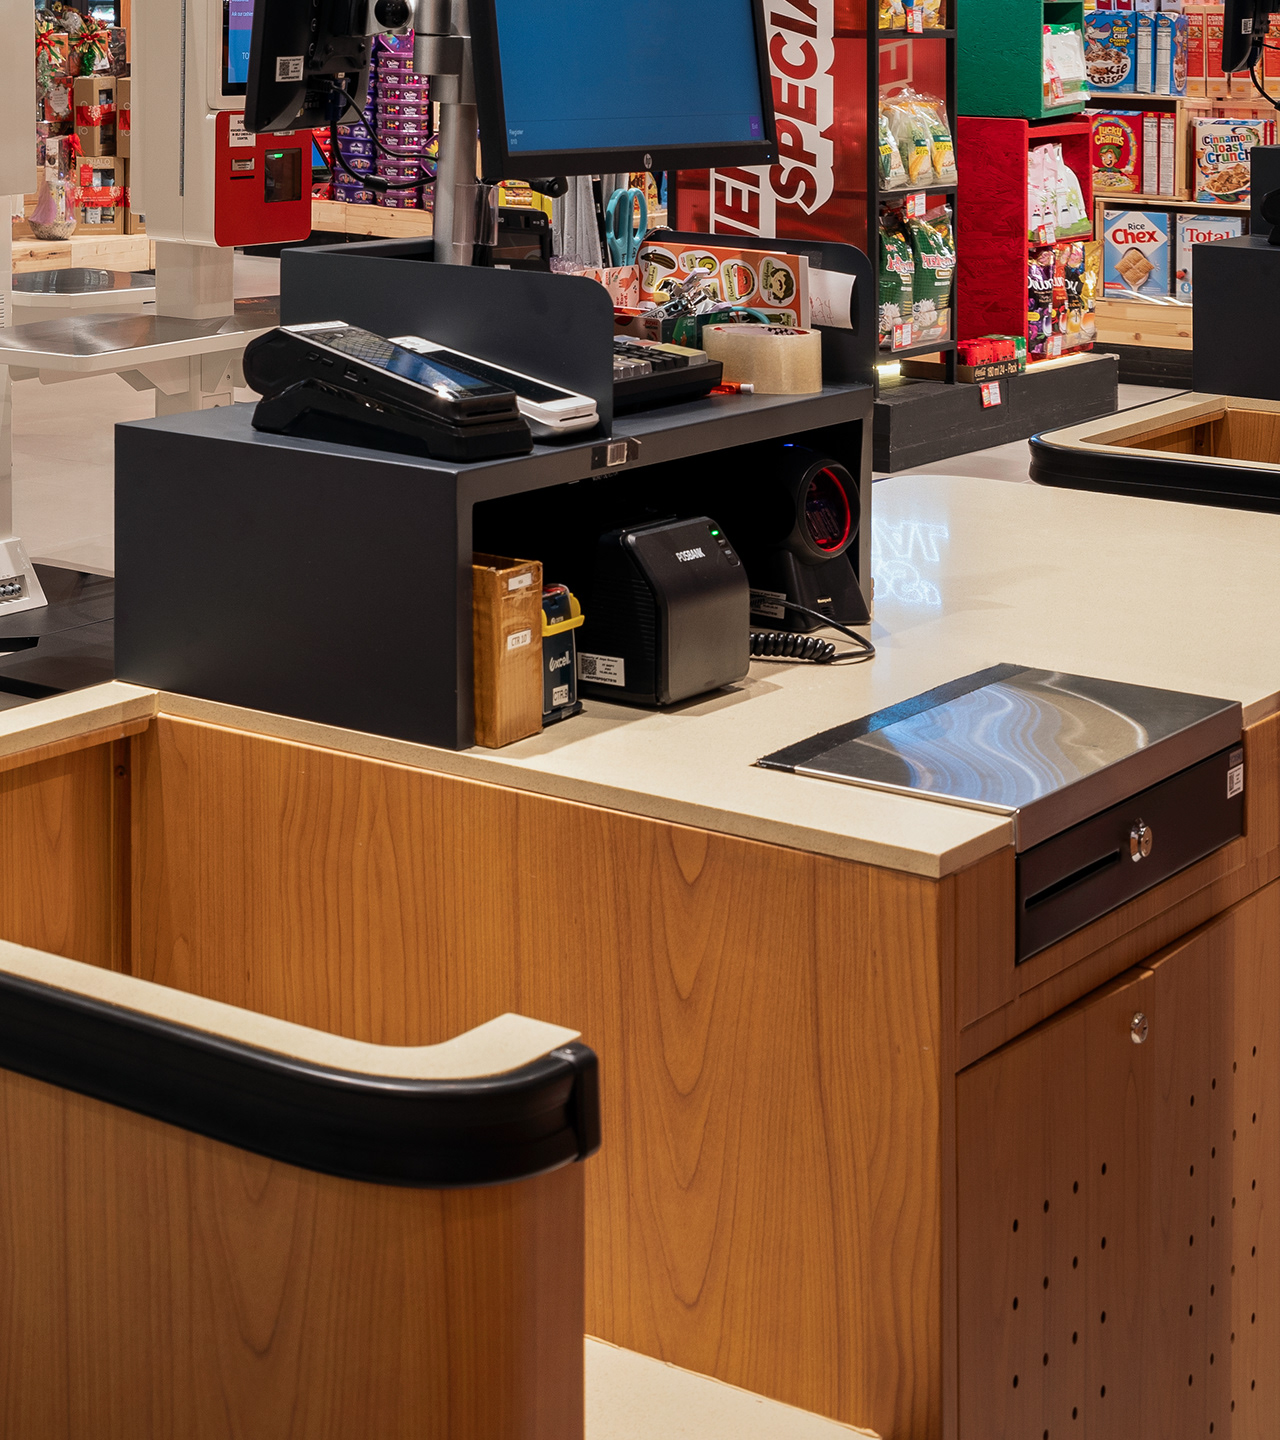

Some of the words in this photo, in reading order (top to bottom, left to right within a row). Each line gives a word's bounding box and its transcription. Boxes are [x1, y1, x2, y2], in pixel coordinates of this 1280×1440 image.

[1098, 126, 1122, 137] Lucky
[1094, 136, 1124, 145] Charms
[1204, 134, 1252, 144] Cinnamon
[1214, 143, 1244, 152] Toast
[1208, 151, 1251, 163] Crunch
[1112, 229, 1158, 244] Chex
[675, 548, 705, 562] POSBANK
[511, 636, 520, 646] CTR
[521, 634, 527, 643] 10
